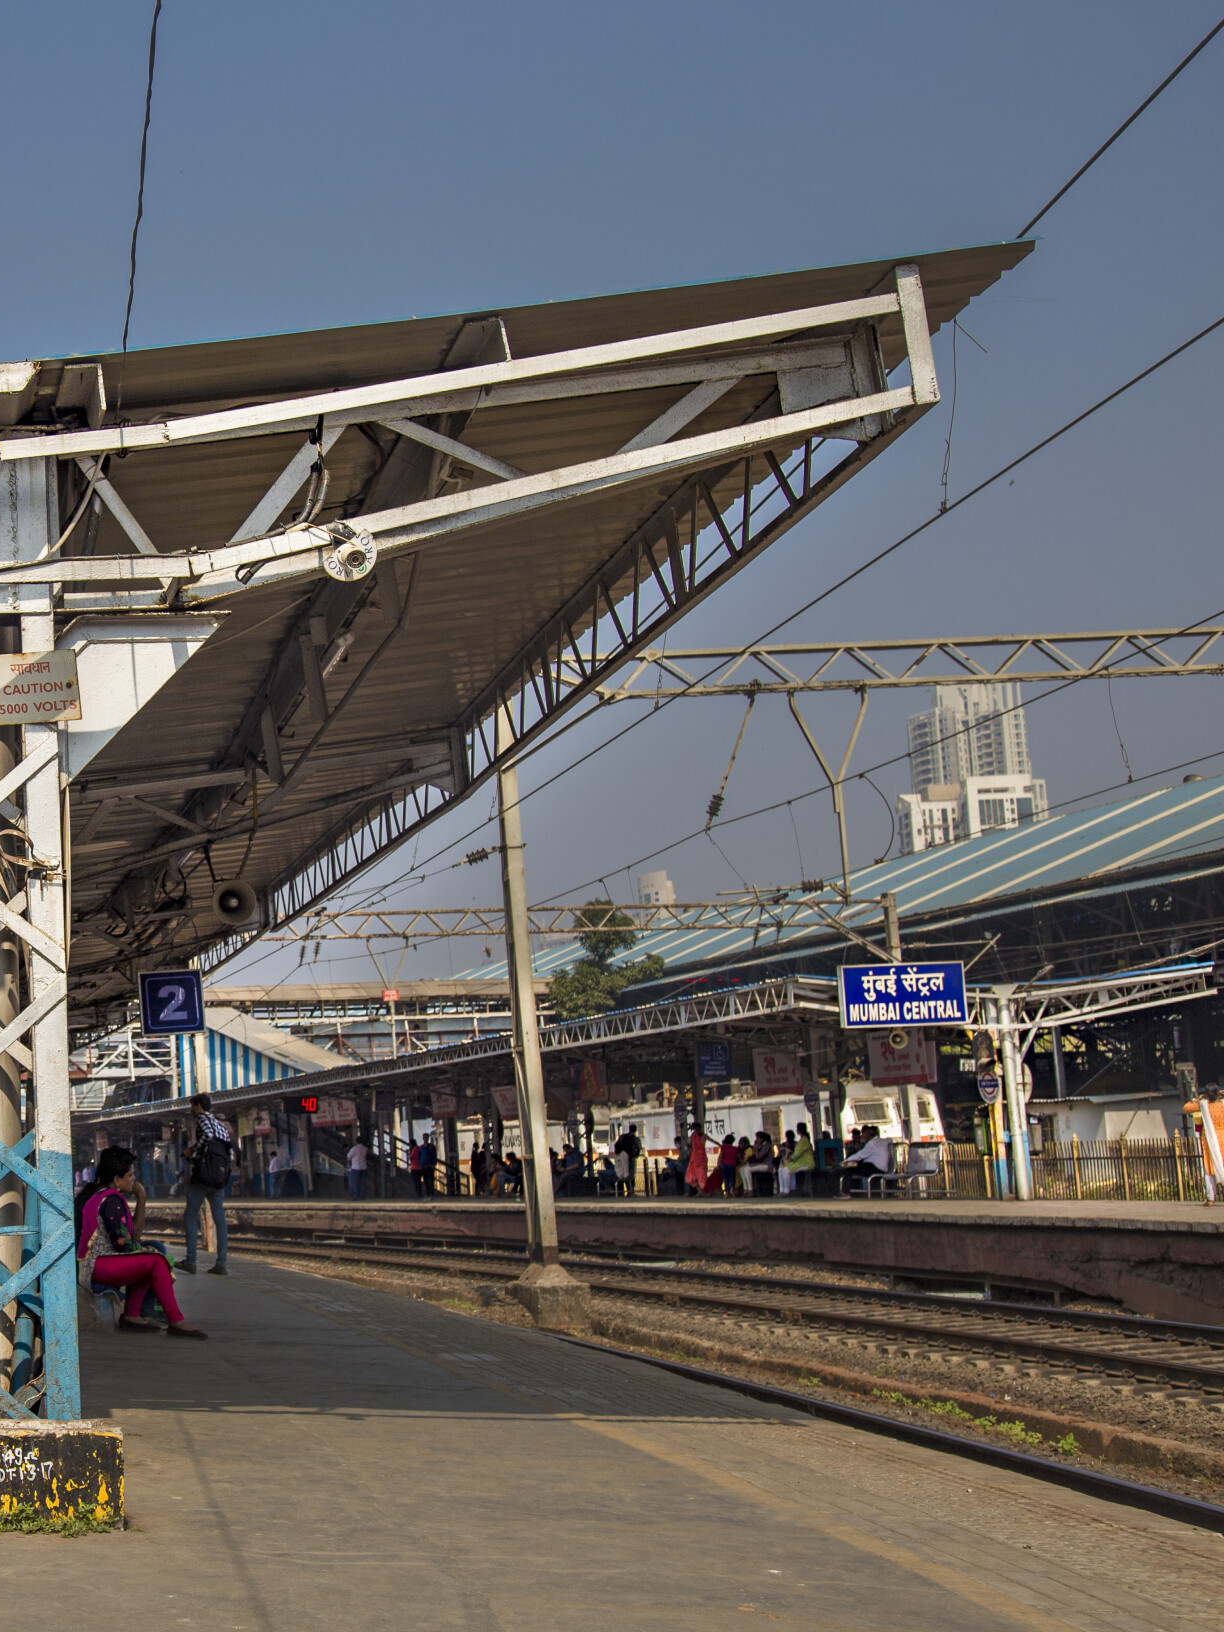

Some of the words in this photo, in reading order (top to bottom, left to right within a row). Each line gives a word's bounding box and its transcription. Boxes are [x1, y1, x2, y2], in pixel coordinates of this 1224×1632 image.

[10, 661, 51, 675] सावधान
[3, 681, 64, 696] CAUTION
[33, 699, 78, 713] VOLTS
[861, 968, 897, 1001] मुंबई
[901, 967, 944, 996] सेंट्रल
[158, 985, 188, 1021] 2
[849, 1002, 900, 1022] MUMBAI
[903, 1000, 961, 1020] CENTRAL
[301, 1098, 317, 1111] 40
